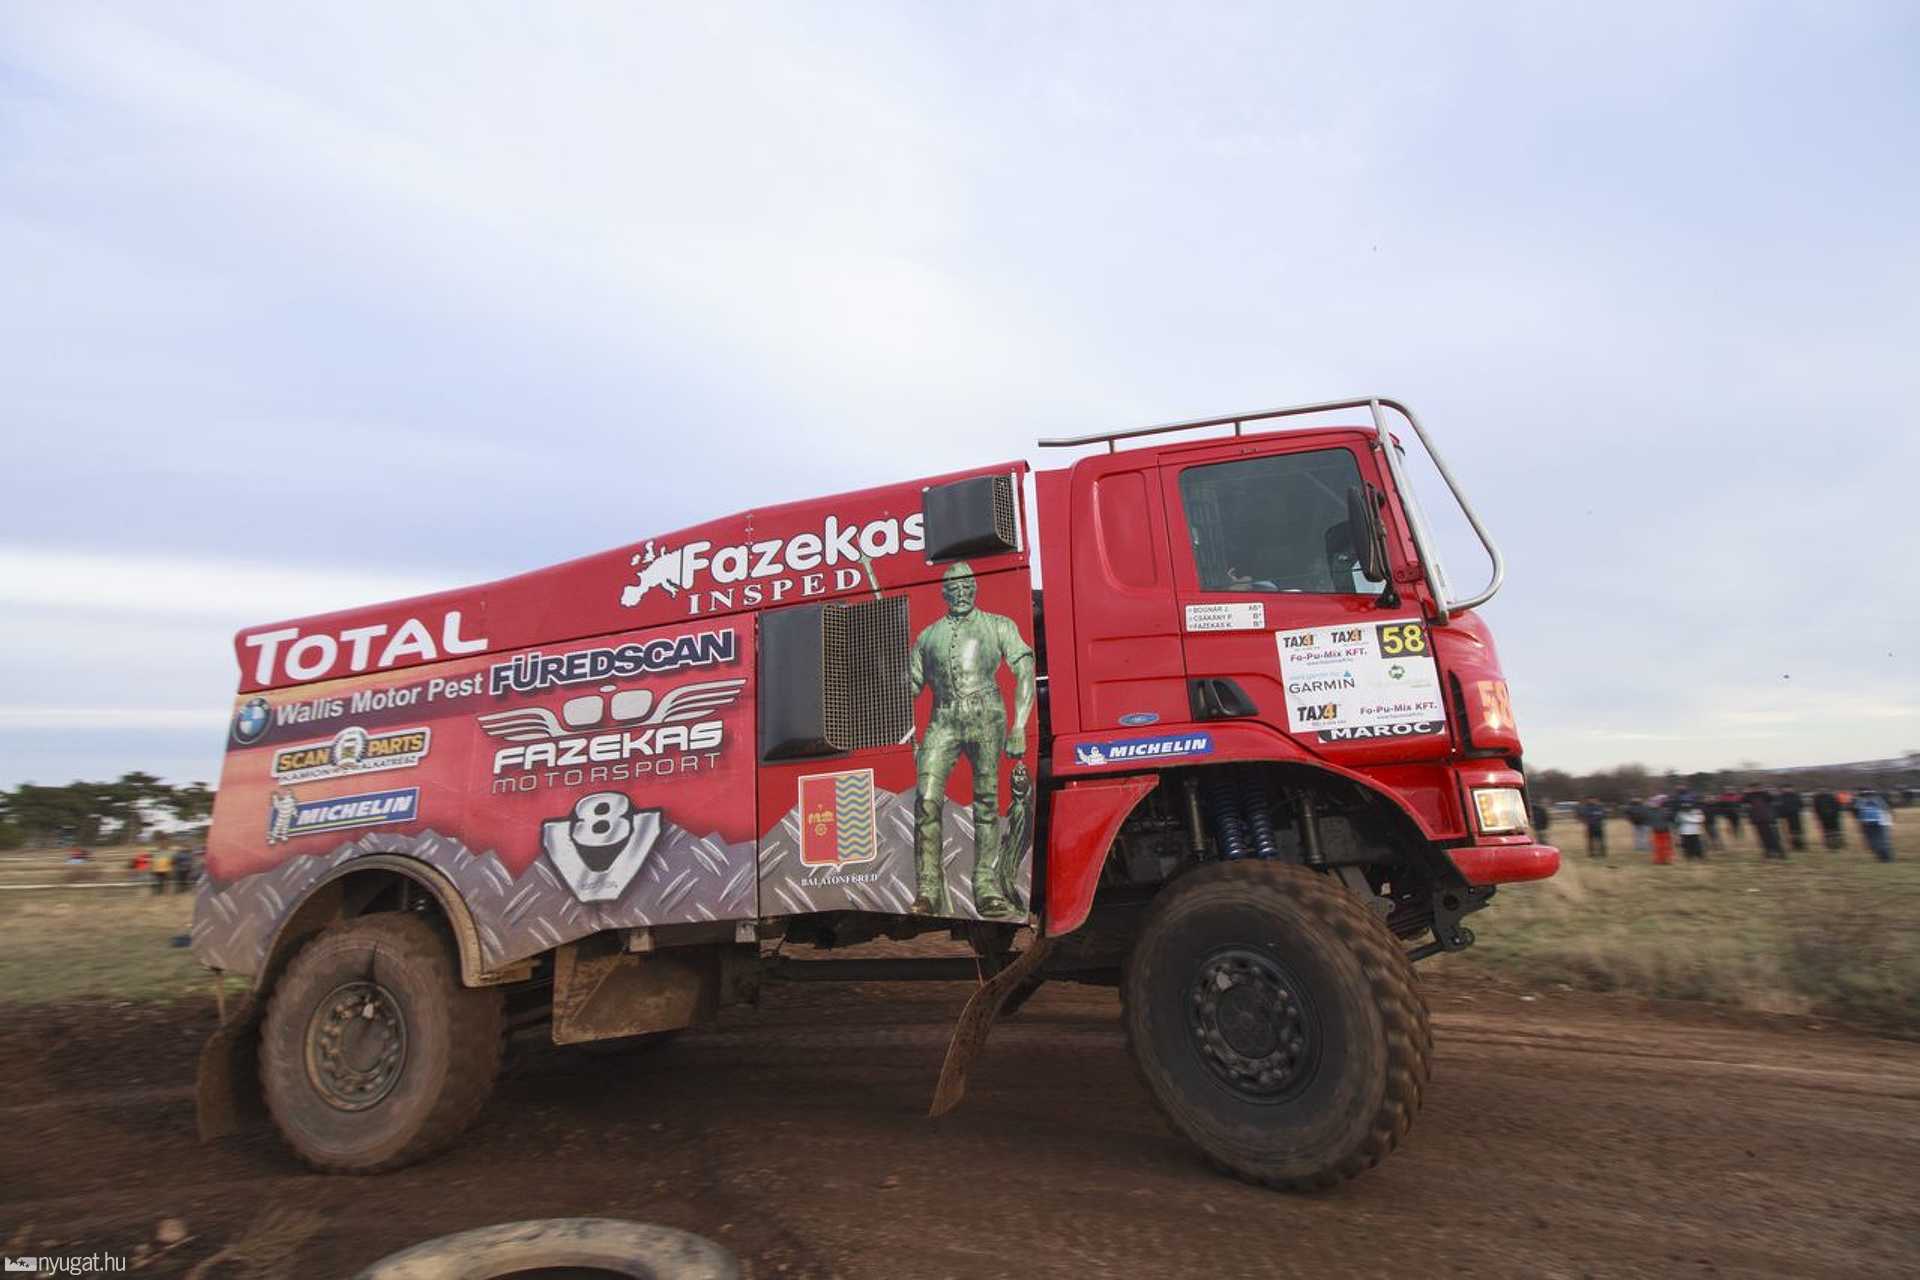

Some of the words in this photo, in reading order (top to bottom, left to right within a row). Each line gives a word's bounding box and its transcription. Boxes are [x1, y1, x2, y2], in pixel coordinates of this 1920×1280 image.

[680, 512, 925, 589] Fazekas
[687, 568, 862, 616] INSPED
[245, 611, 488, 686] TOTAL
[1381, 624, 1425, 654] 58
[489, 628, 734, 695] FÜREDSCAN
[276, 698, 344, 728] Wallis
[351, 686, 419, 715] Motor
[427, 673, 483, 701] Pest
[1289, 678, 1355, 694] GARMIN
[493, 720, 724, 775] FAZEKAS
[1109, 738, 1207, 758] MICHELIN
[1329, 721, 1433, 740] MAROC
[279, 748, 331, 771] SCAN
[366, 734, 425, 757] PARTS
[491, 752, 721, 795] MOTORSPORT
[296, 794, 414, 826] MICHELIN
